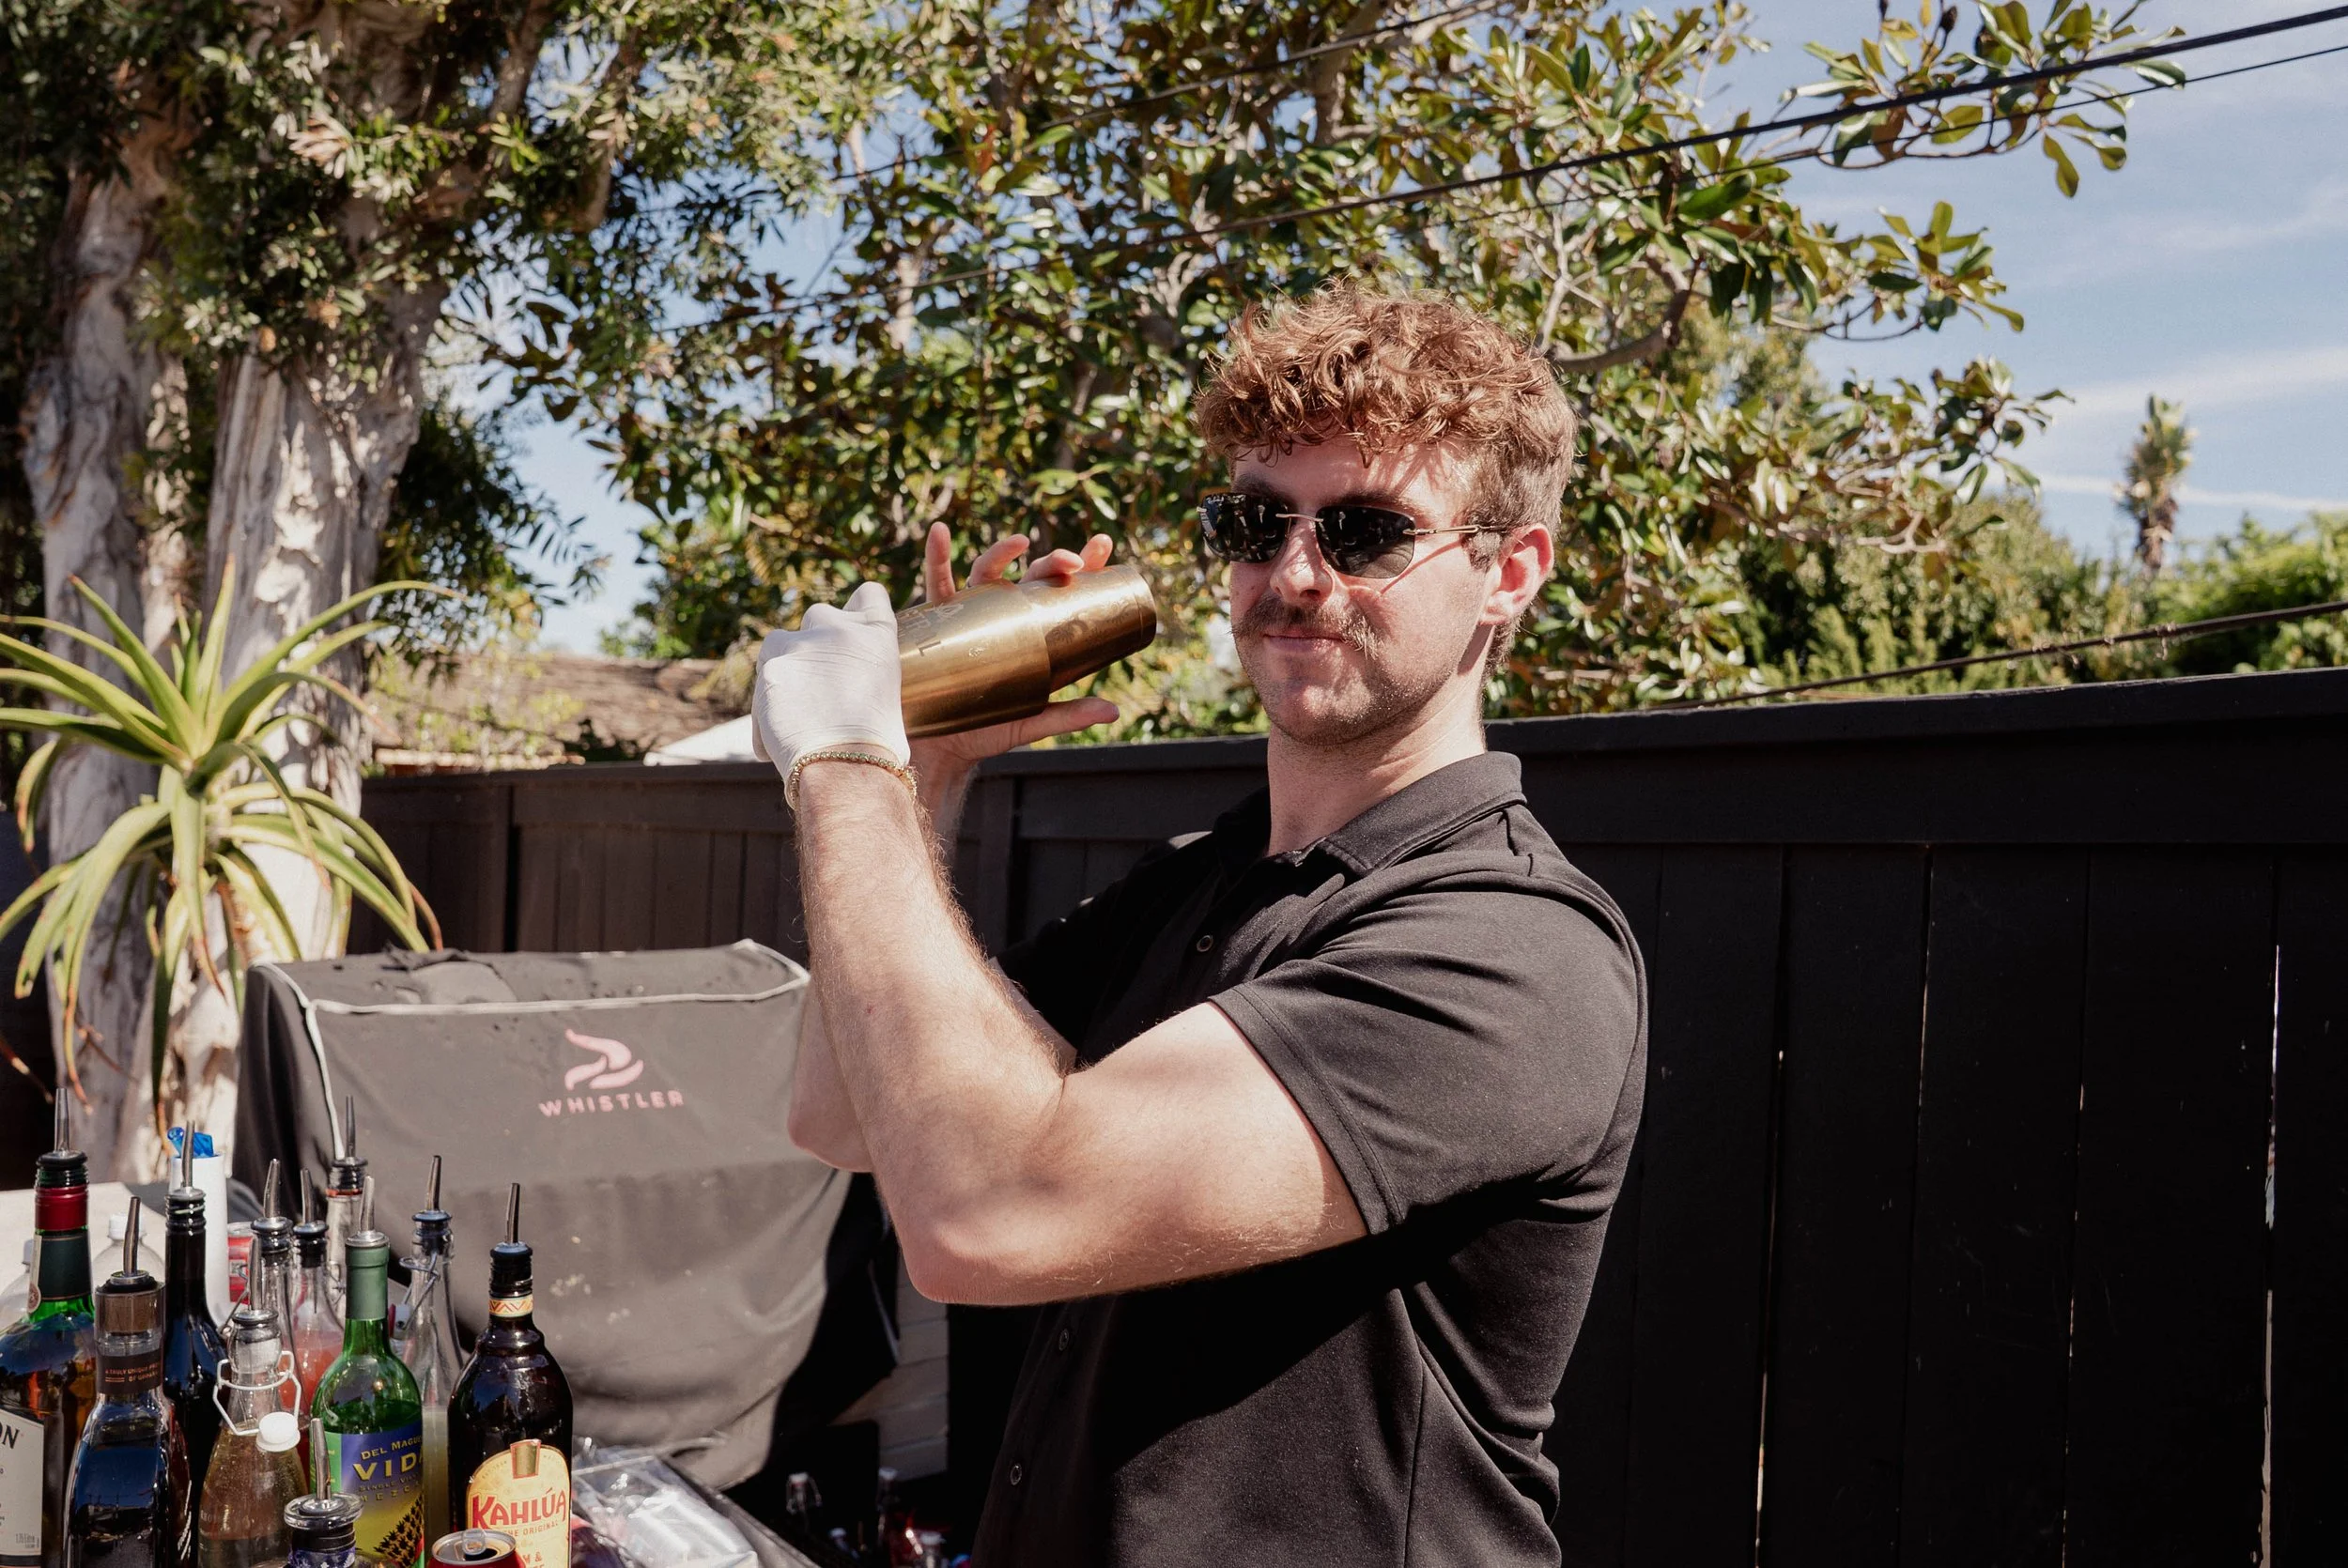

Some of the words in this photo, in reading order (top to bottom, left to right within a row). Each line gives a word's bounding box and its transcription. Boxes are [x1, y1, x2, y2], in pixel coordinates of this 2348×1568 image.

[538, 1089, 685, 1117] WHISTLER
[361, 1447, 388, 1461] DEL
[472, 1486, 567, 1530] KAHLÚA
